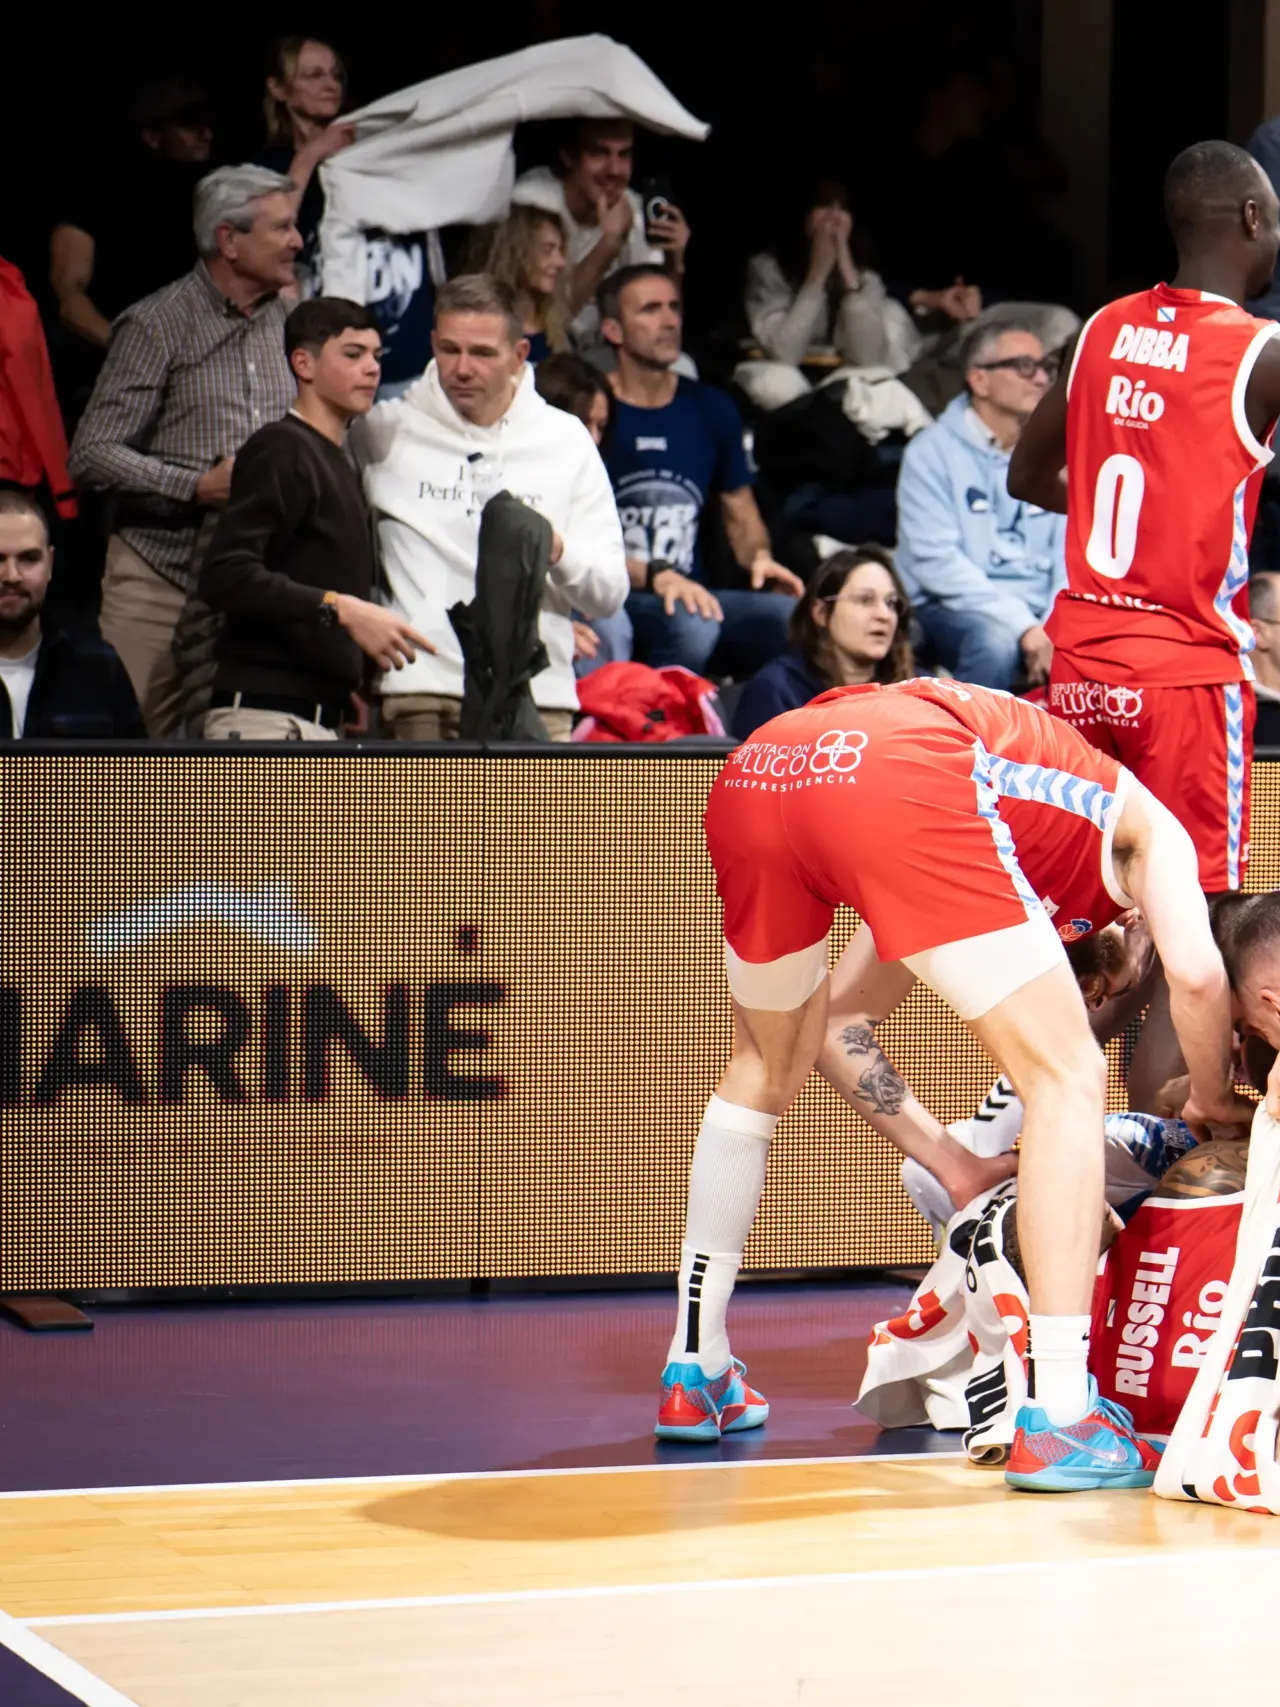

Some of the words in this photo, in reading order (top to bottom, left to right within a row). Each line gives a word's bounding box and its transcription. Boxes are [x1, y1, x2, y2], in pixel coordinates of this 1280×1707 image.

[1109, 323, 1190, 373] DIBBA
[1105, 375, 1165, 422] Río
[1085, 453, 1146, 580] 0
[739, 742, 812, 758] DEPUTACIÓN
[741, 752, 807, 778] LUGO
[724, 774, 857, 793] VICEPRESIDENCIA
[1115, 1246, 1181, 1398] RUSSELL
[1171, 1279, 1229, 1369] Río
